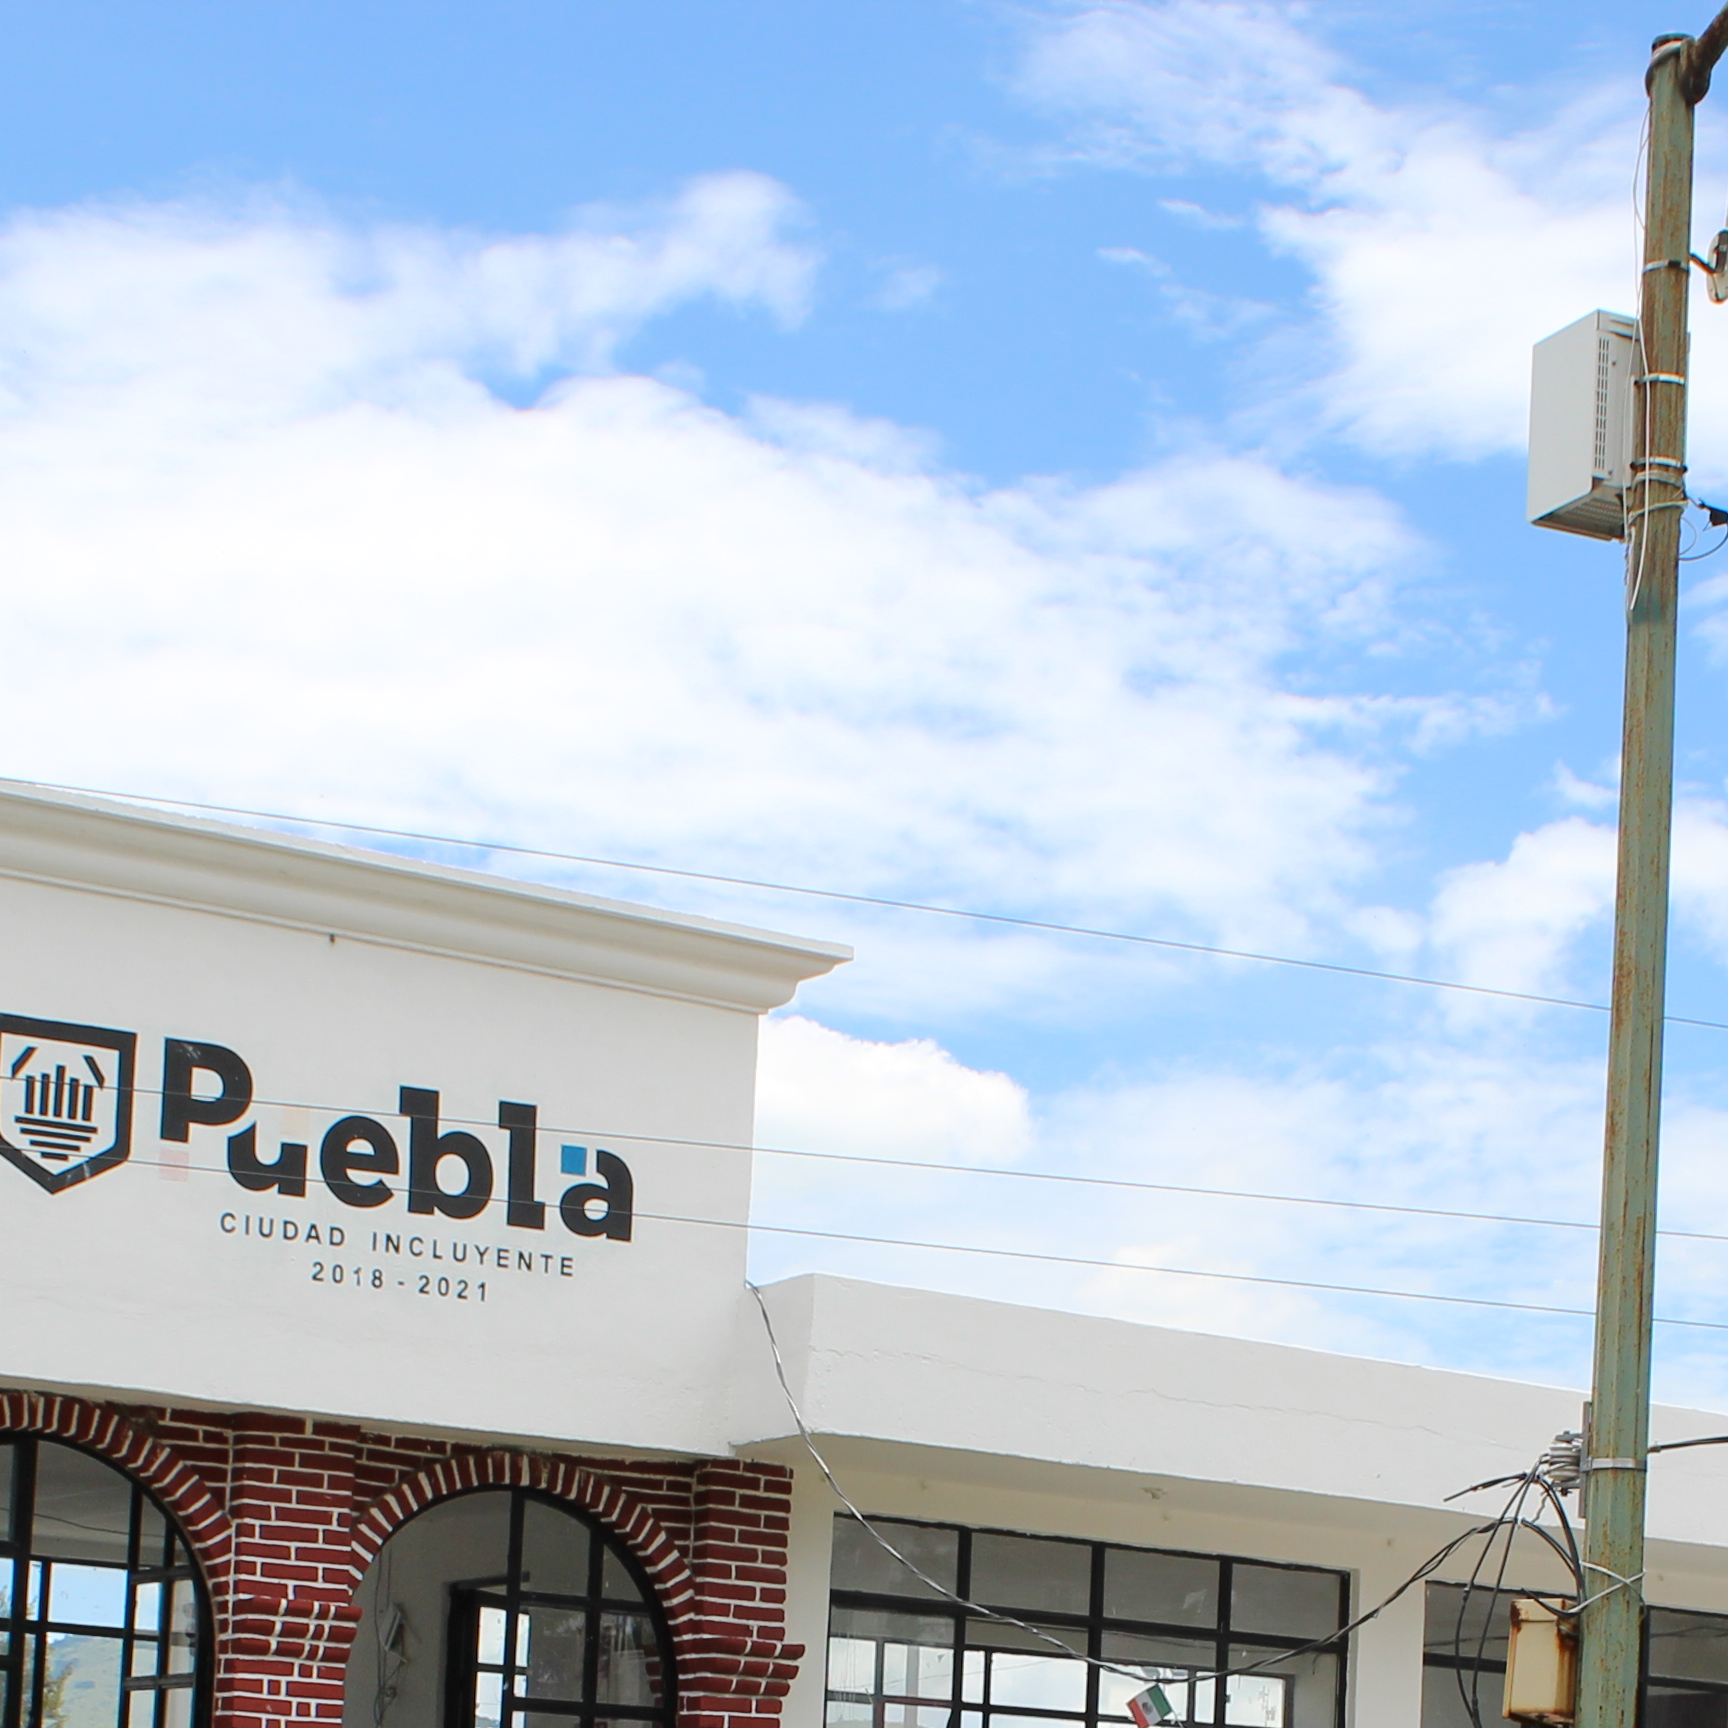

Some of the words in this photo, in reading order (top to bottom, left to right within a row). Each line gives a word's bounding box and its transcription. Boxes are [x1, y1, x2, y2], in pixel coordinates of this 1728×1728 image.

[159, 1037, 634, 1243] Puebla
[220, 1212, 346, 1247] CIUDAD
[371, 1231, 574, 1277] INCLUYENTE
[311, 1261, 384, 1289] 2018
[418, 1274, 487, 1302] 2021
